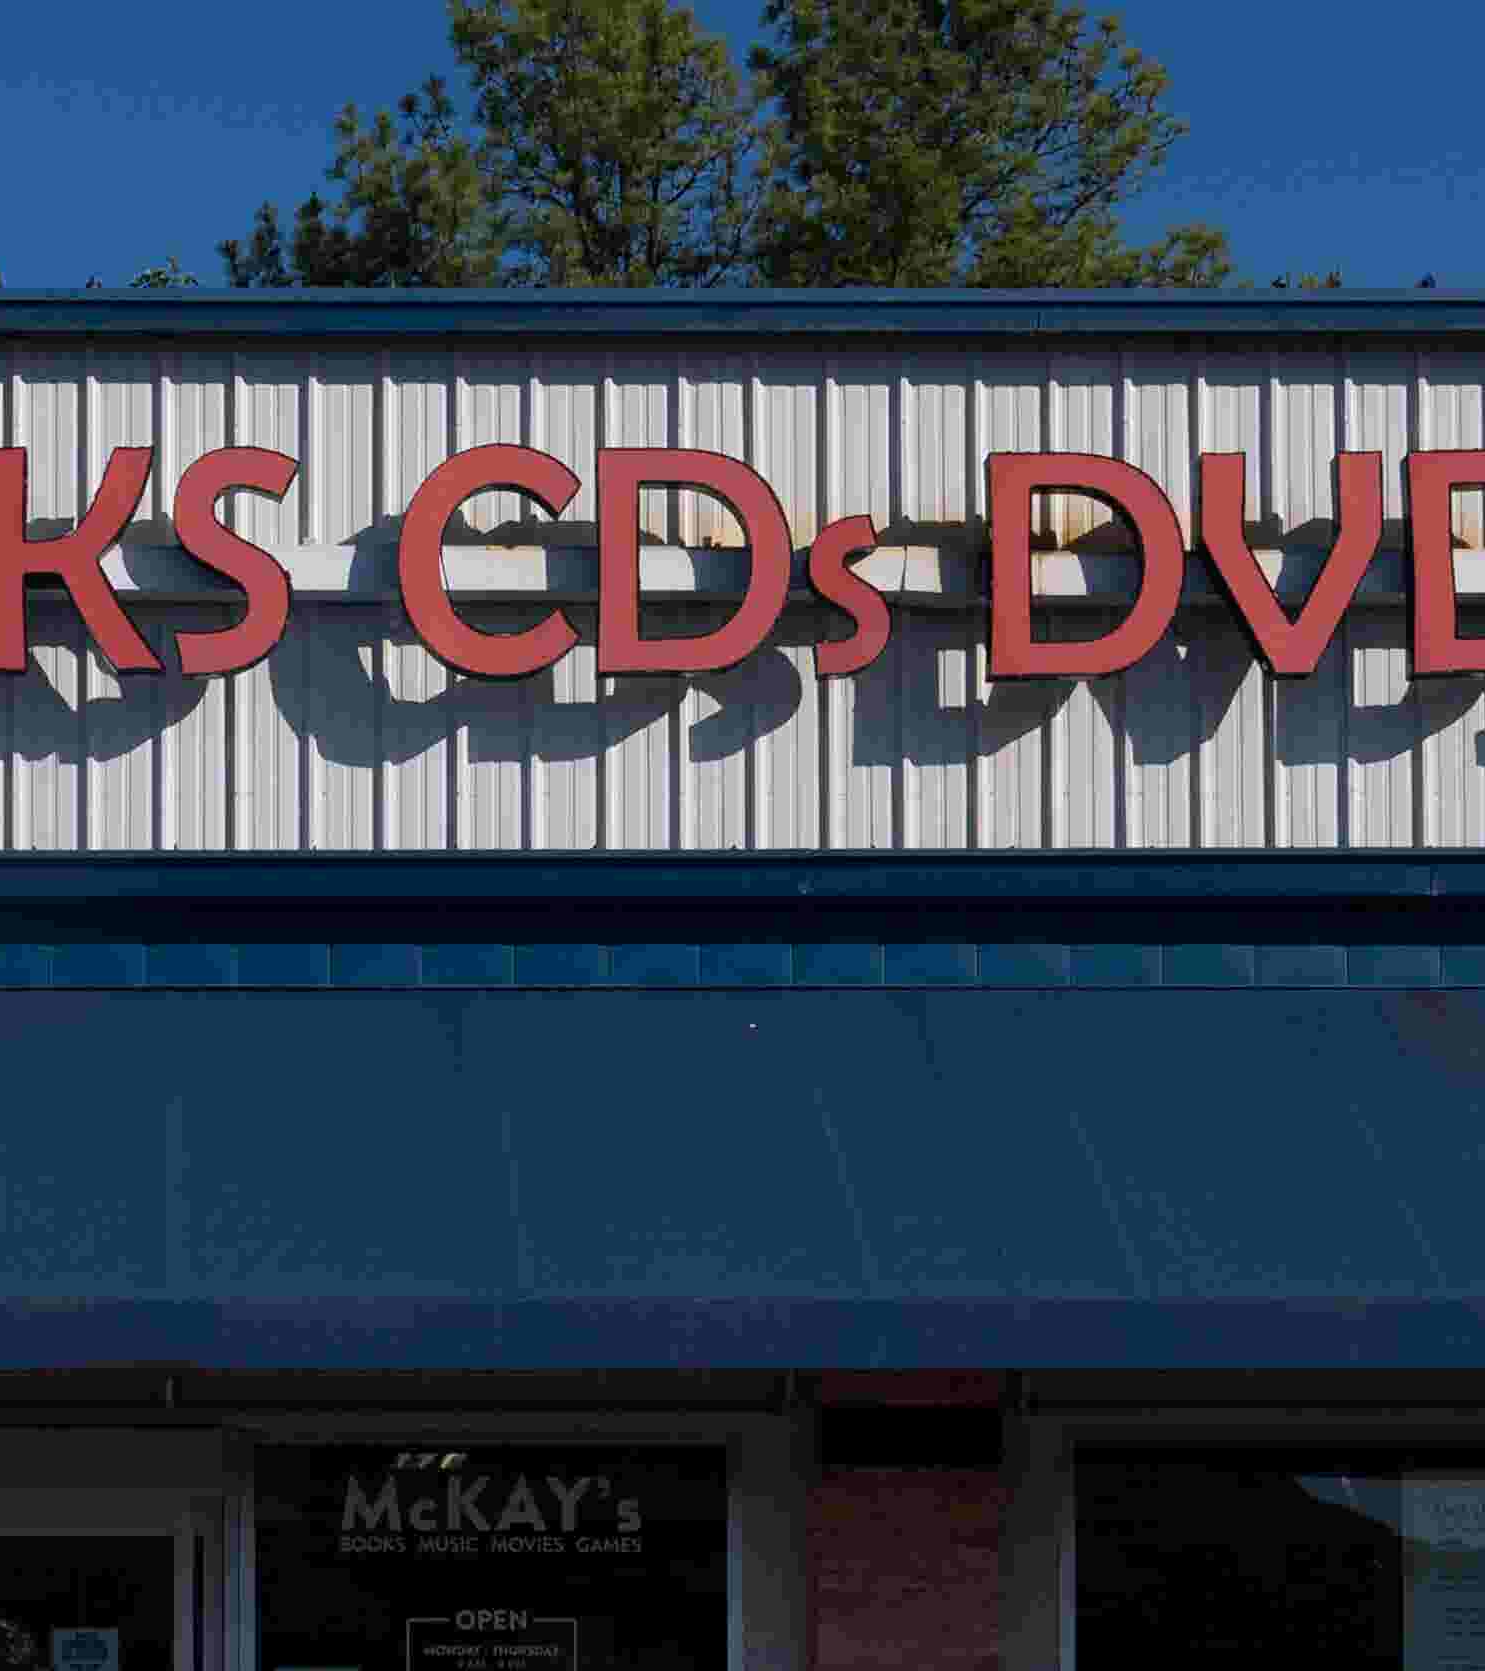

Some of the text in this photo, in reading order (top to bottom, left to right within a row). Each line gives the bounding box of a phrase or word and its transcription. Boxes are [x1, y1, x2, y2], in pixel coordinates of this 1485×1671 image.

[398, 442, 894, 681] CDs
[341, 1473, 642, 1533] McKAY's
[341, 1536, 642, 1553] BOOKS MUSIC MOVIES GAMES
[455, 1609, 527, 1632] OPEN
